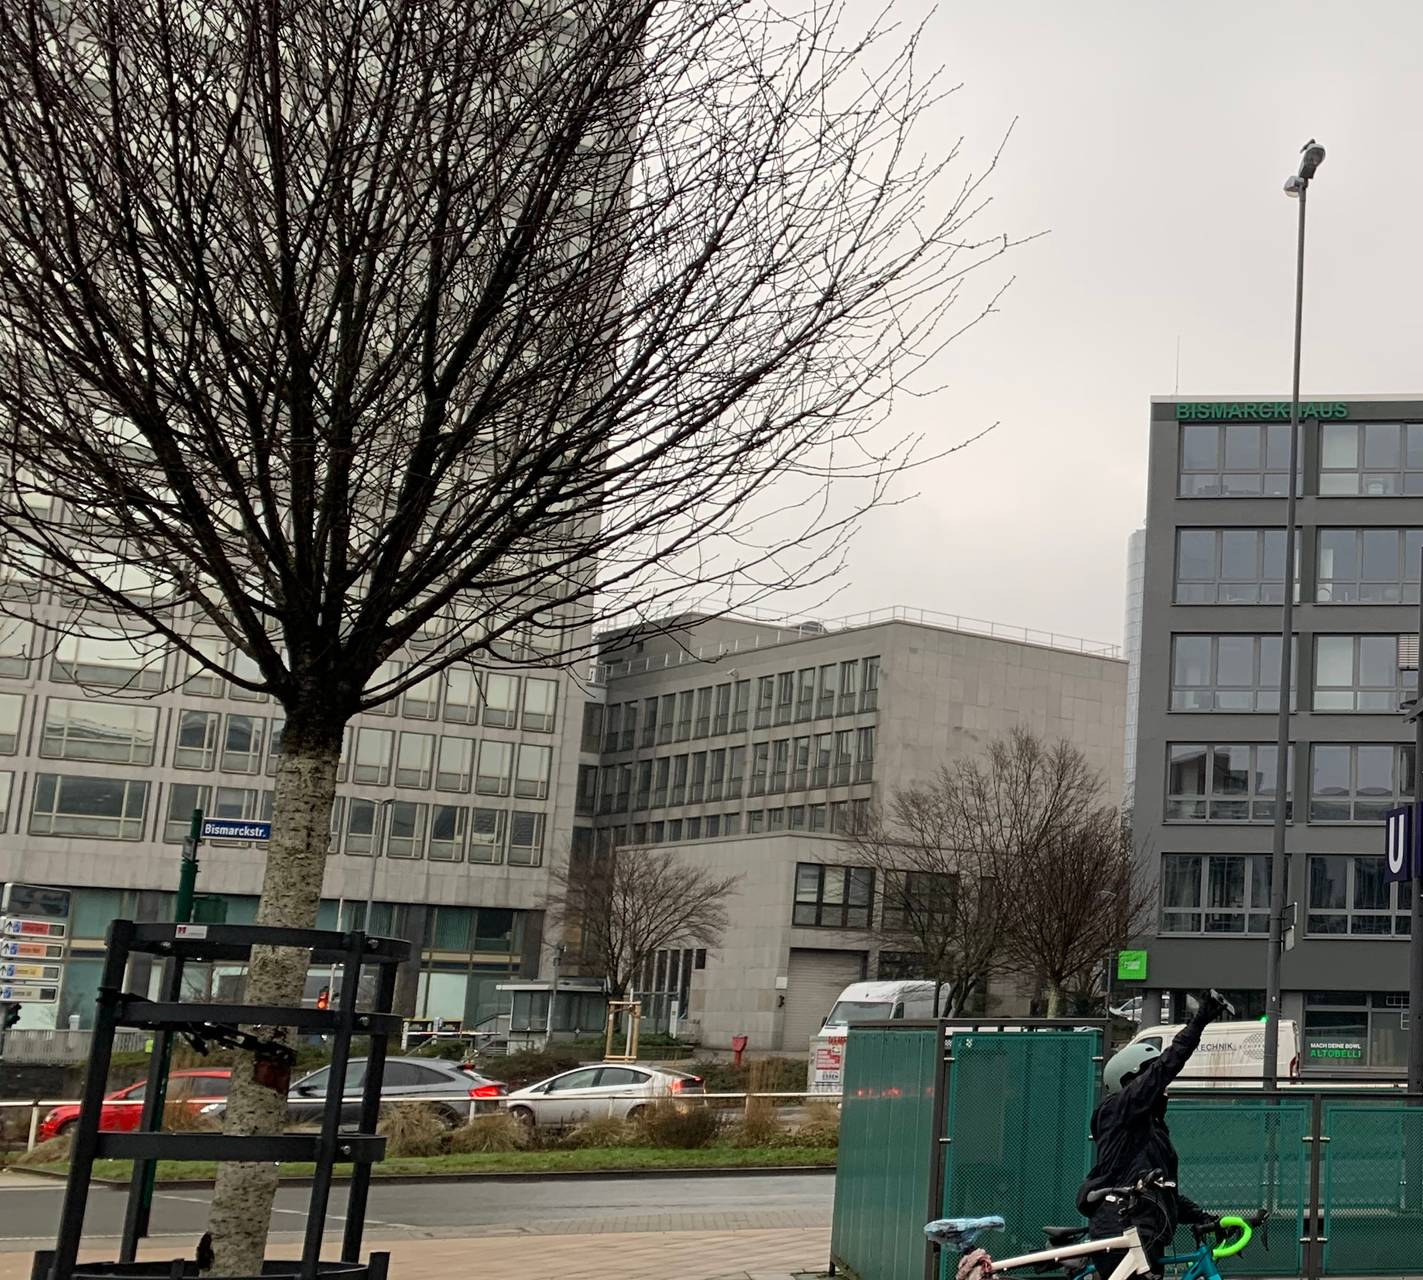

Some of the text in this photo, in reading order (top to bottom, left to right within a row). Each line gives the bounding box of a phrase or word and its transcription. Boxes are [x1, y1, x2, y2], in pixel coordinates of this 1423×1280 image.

[204, 823, 266, 838] Bismarckstr.
[1389, 814, 1405, 874] U
[1310, 1049, 1361, 1058] ALTOBELLI
